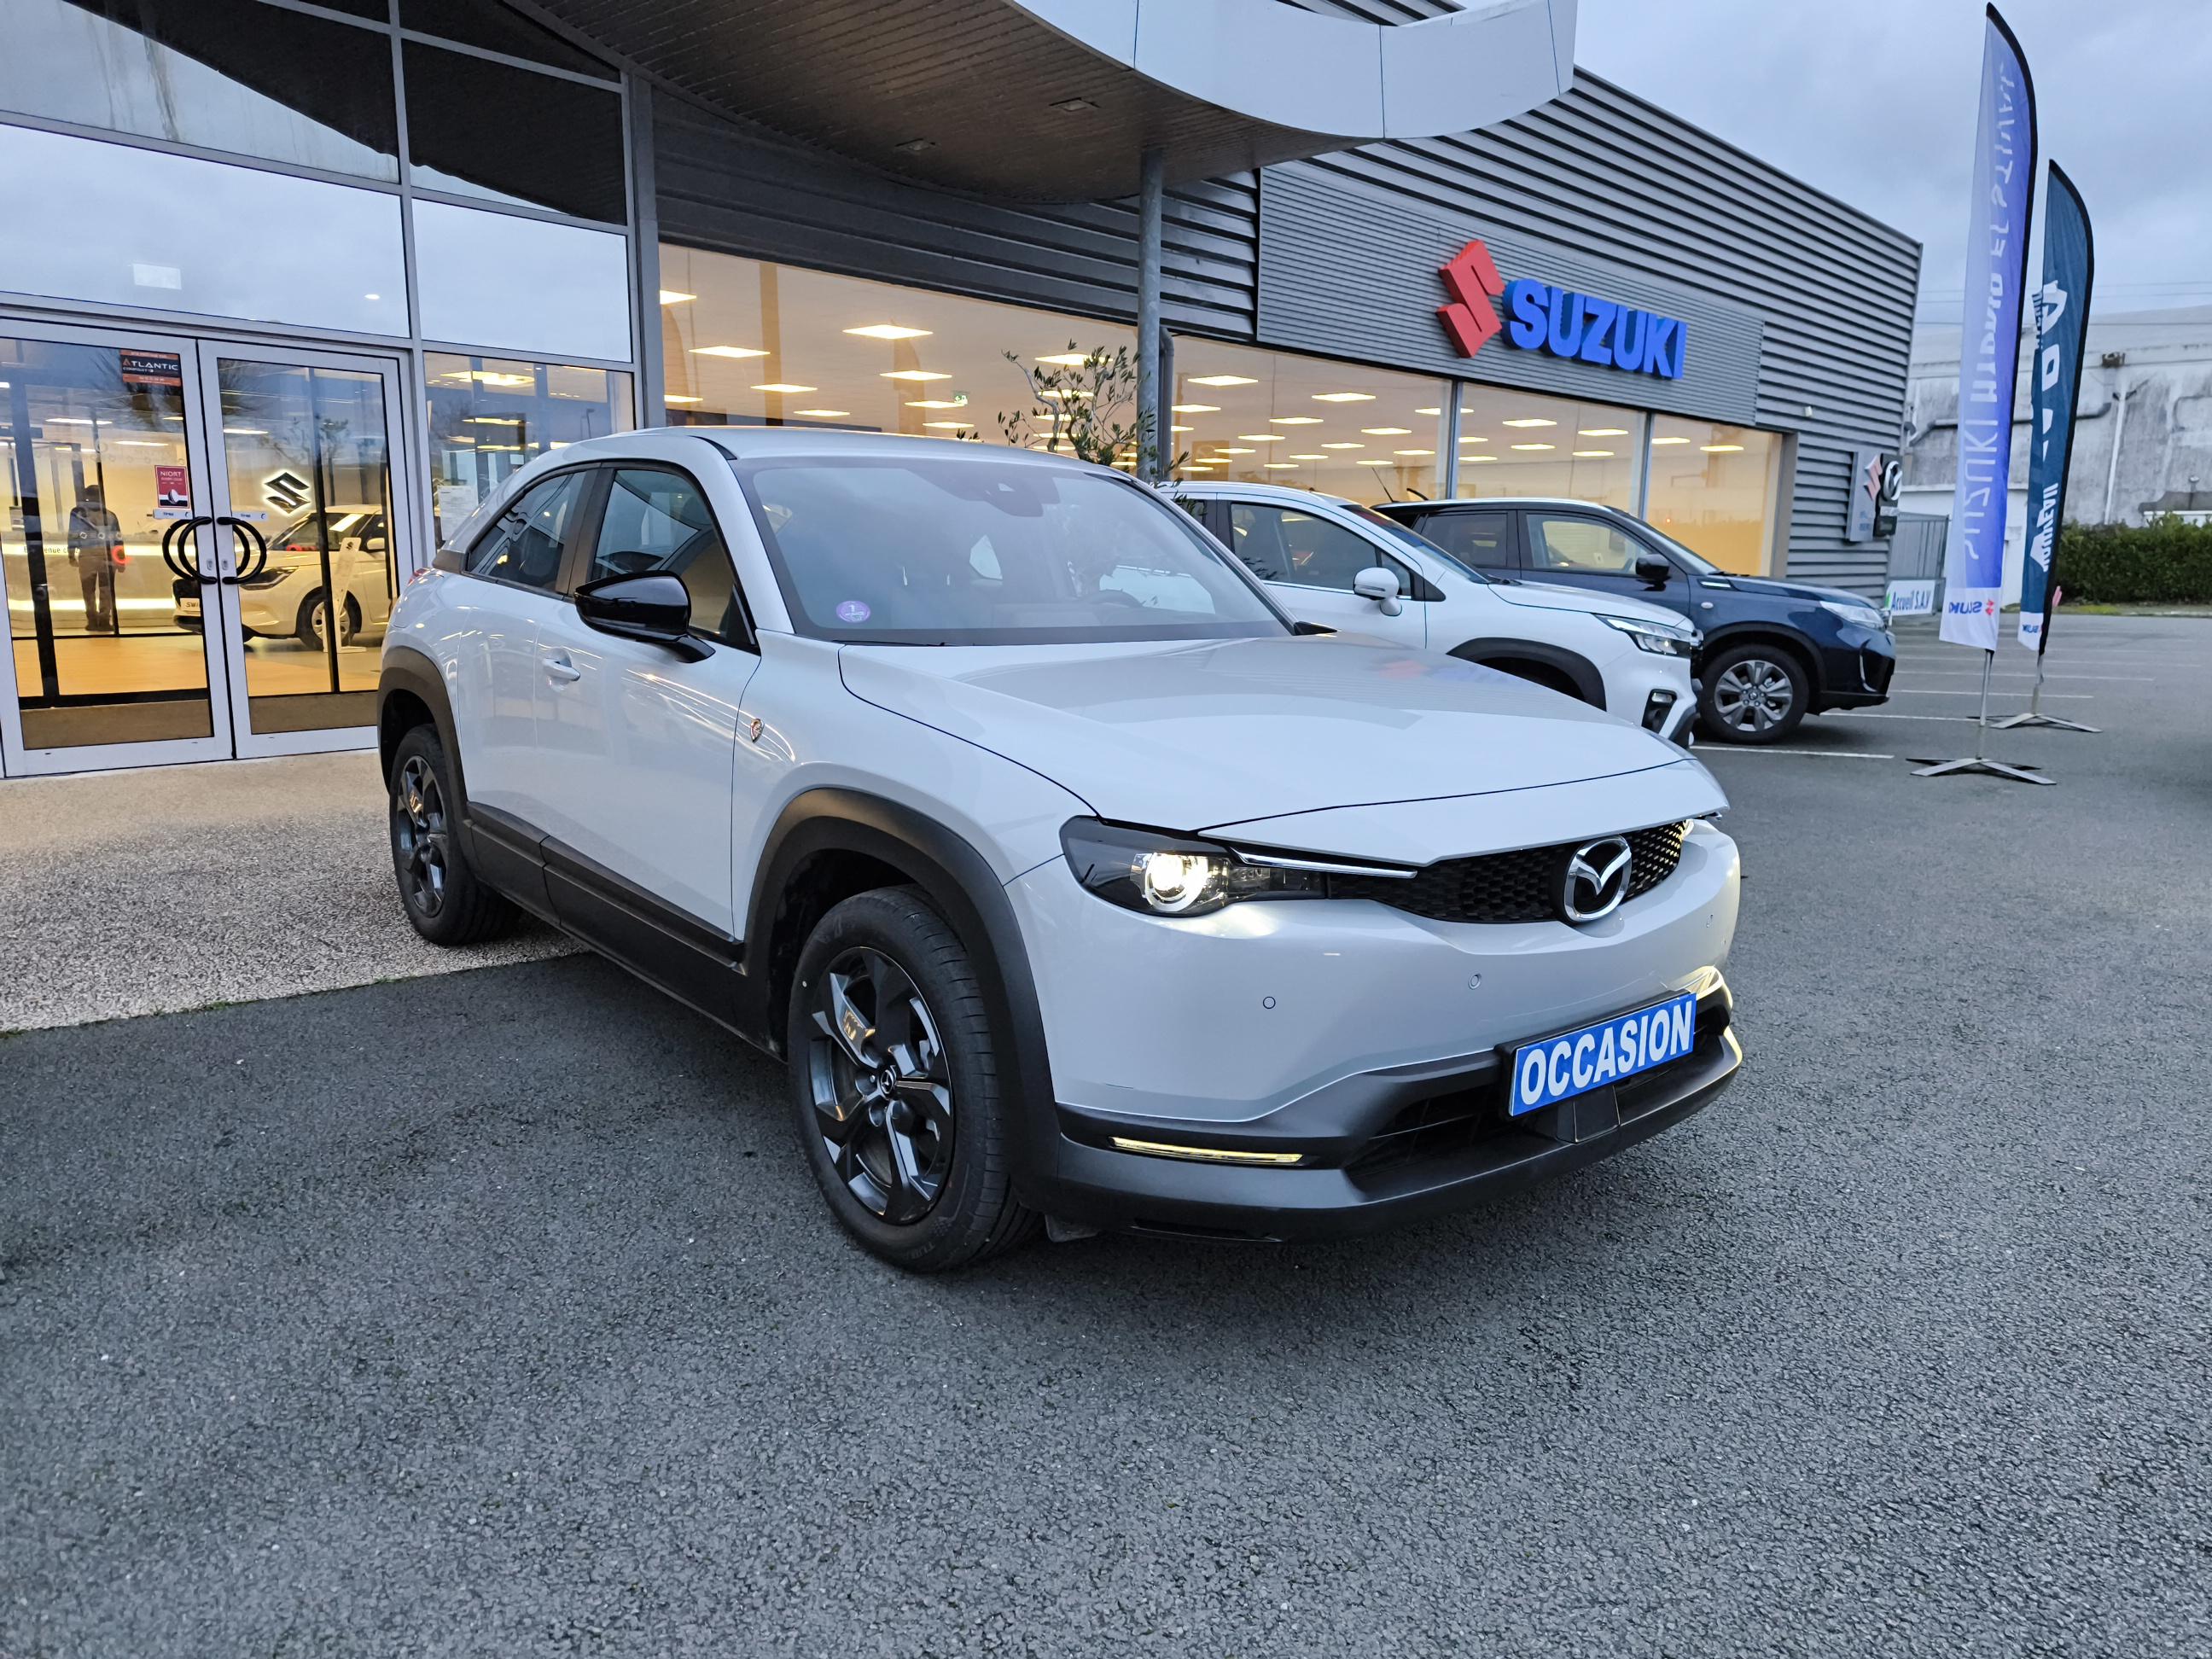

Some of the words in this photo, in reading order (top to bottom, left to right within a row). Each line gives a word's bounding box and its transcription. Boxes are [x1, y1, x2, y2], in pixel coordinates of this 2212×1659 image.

[123, 358, 178, 370] ATLANTIC
[1502, 278, 1688, 380] SUZUKI
[1520, 1000, 1692, 1106] OCCASION
